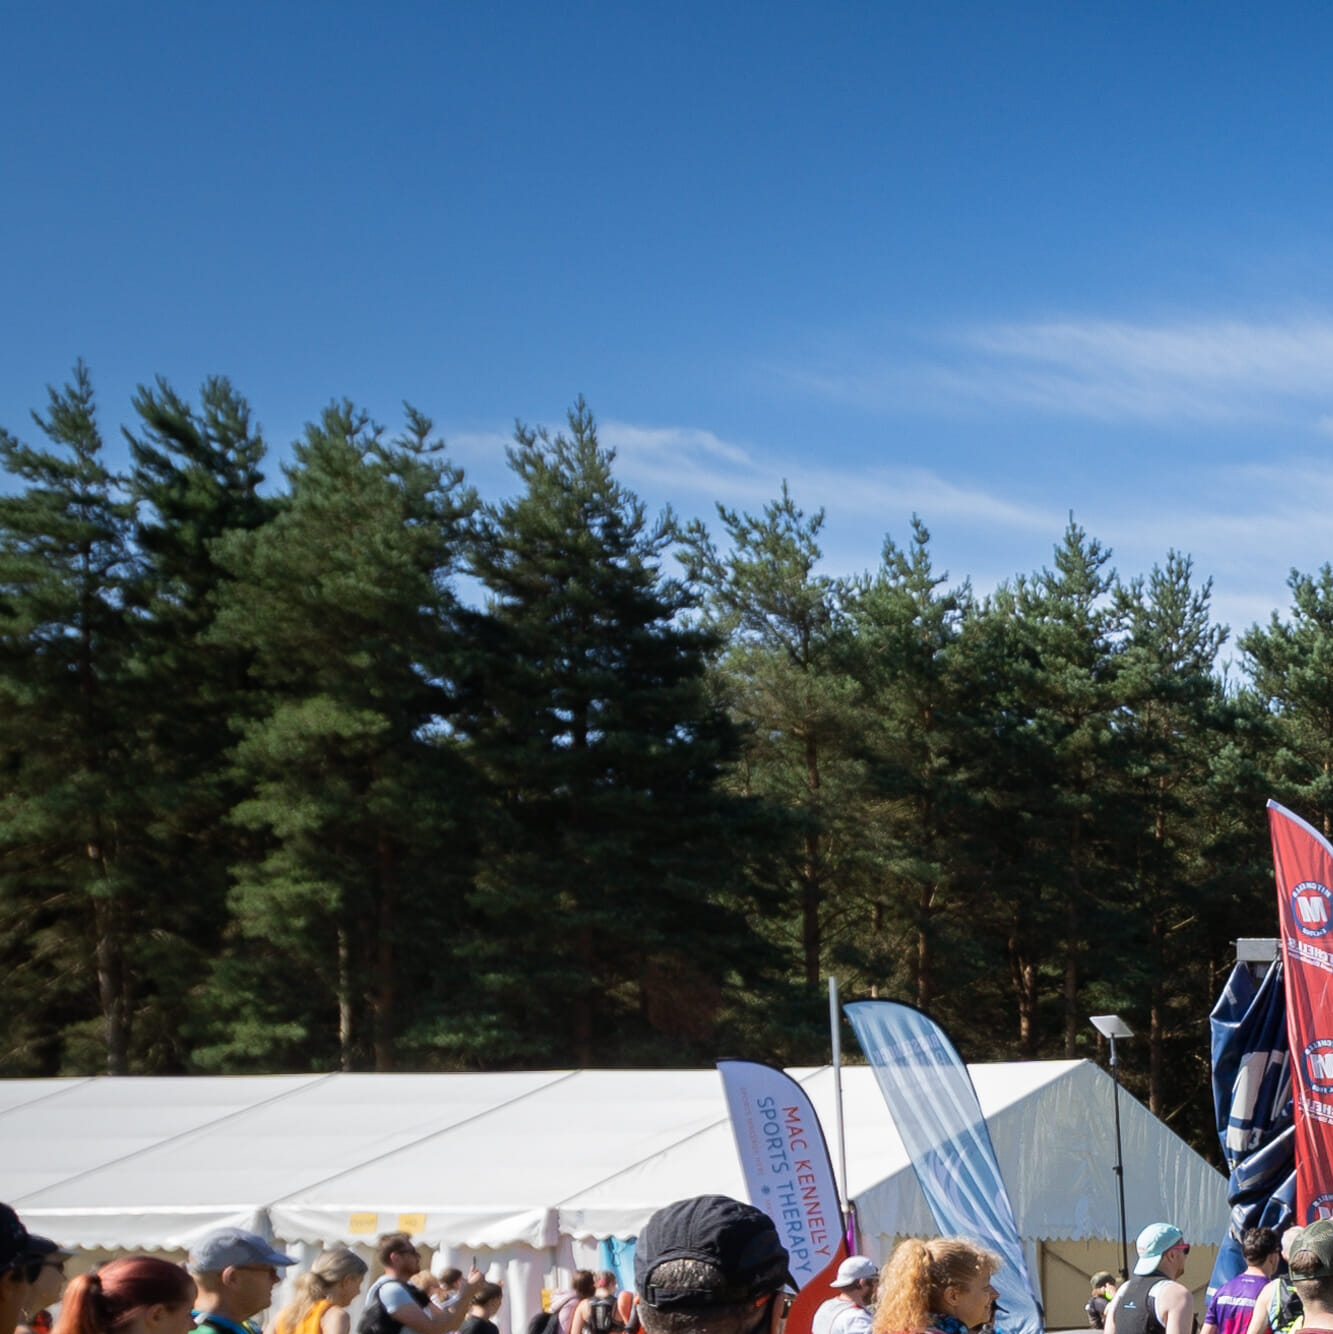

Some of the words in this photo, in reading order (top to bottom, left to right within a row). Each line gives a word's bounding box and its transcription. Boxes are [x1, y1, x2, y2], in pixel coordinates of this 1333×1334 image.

[782, 1105, 808, 1152] MAC
[756, 1096, 789, 1174] SPORTS
[777, 1183, 813, 1274] THERAPY
[794, 1159, 831, 1257] KENNELLY
